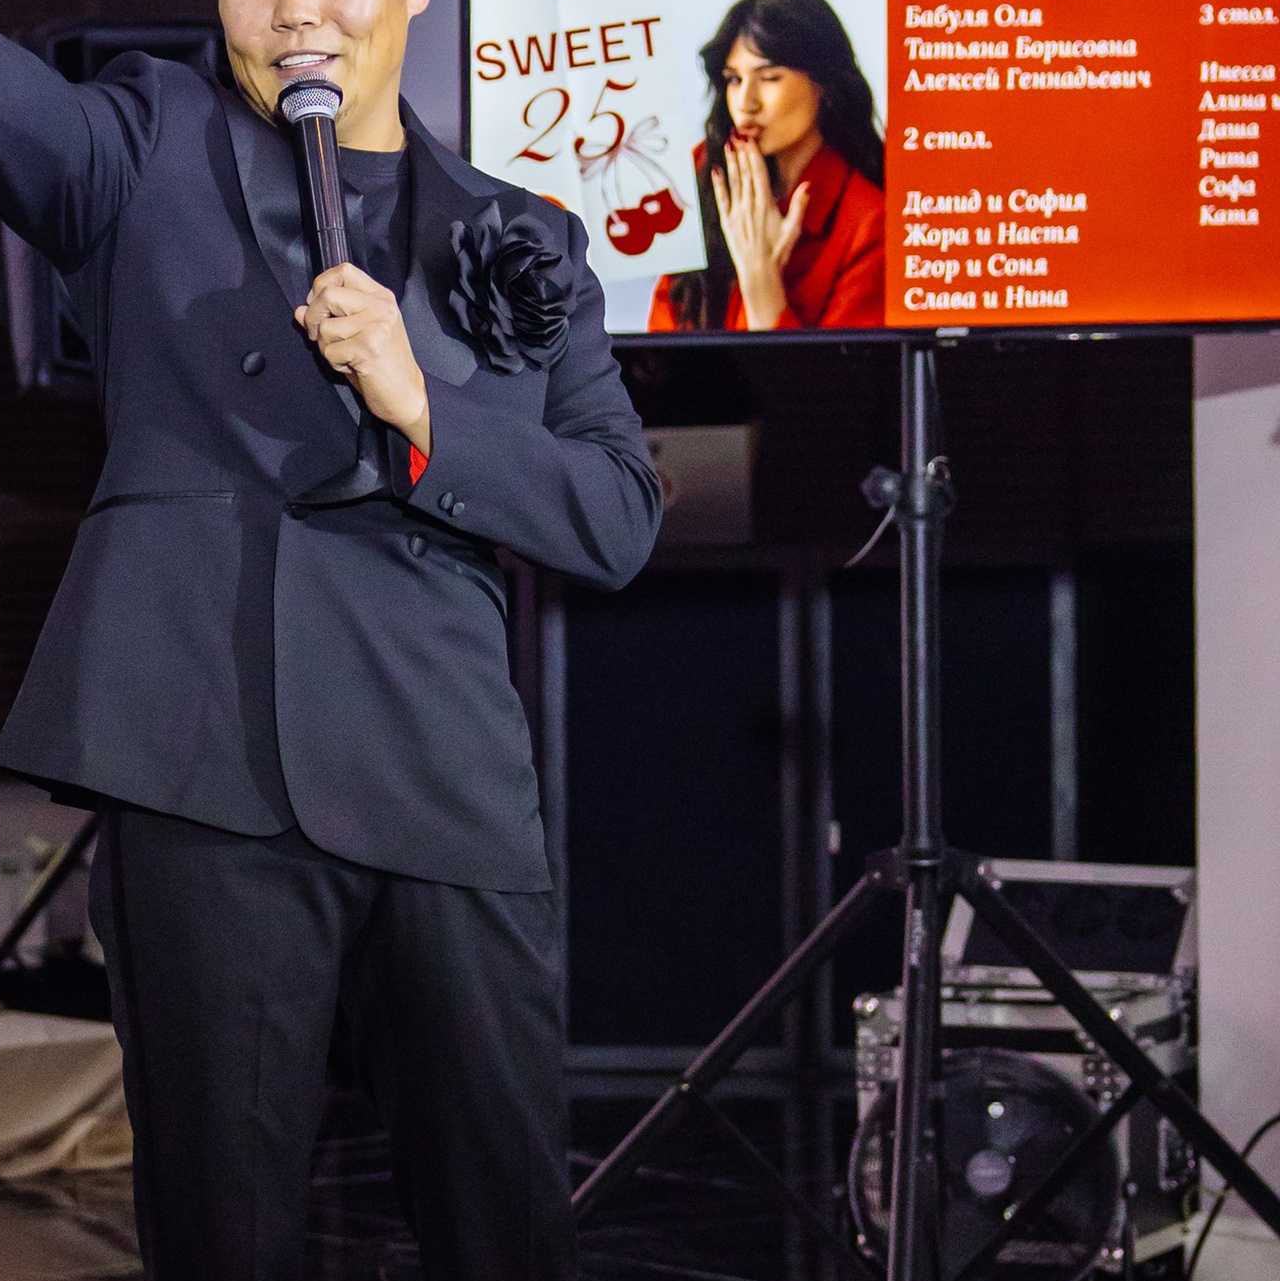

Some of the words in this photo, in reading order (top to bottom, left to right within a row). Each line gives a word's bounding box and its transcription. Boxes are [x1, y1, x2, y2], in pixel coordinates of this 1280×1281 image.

[905, 3, 989, 34] Бабуля
[994, 3, 1043, 27] Оля
[1199, 3, 1215, 25] 3
[1217, 7, 1280, 25] стол.
[475, 16, 662, 83] SWEET
[904, 37, 1009, 60] Татьяна
[1015, 35, 1137, 64] Борисовна
[903, 66, 1000, 92] Алексей
[1006, 65, 1152, 90] Геннадьевич
[1200, 61, 1276, 83] Инесса
[1199, 90, 1267, 111] Алина
[505, 76, 638, 167] 25
[1197, 118, 1260, 142] Даша
[903, 126, 919, 150] 2
[923, 130, 993, 150] стол.
[1199, 147, 1259, 169] Рита
[1198, 174, 1256, 203] Софа
[902, 188, 982, 218] Демид
[986, 194, 1003, 213] и
[1008, 187, 1088, 219] София
[1200, 204, 1259, 226] Катя
[903, 223, 970, 252] Жора
[975, 227, 992, 246] и
[997, 221, 1080, 245] Настя
[904, 255, 961, 284] Егор
[965, 258, 982, 277] и
[987, 253, 1048, 277] Соня
[904, 287, 977, 311] Слава
[982, 291, 999, 309] и
[1005, 285, 1069, 309] Нина
